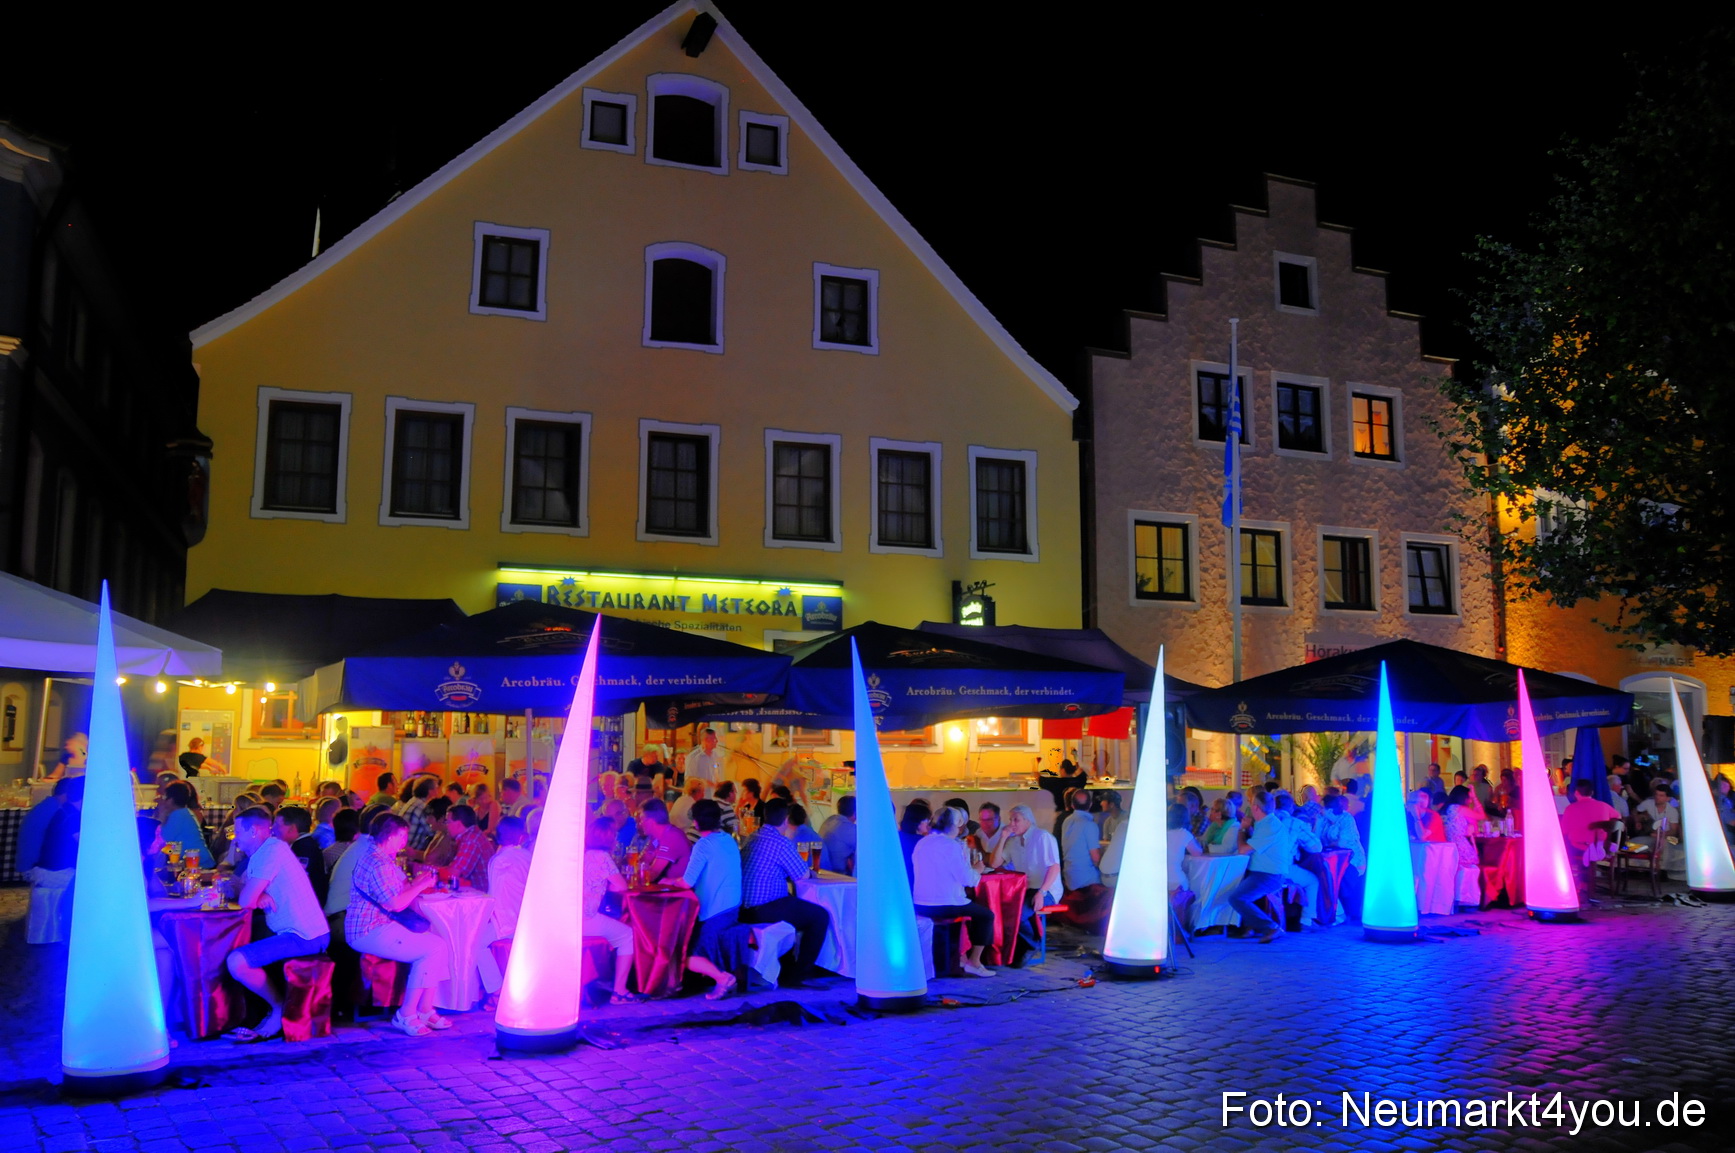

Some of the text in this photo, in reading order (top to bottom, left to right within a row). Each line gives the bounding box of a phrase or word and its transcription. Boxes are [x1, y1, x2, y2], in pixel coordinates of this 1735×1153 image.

[547, 584, 691, 612] RESTAURANT
[702, 593, 798, 617] METEORA
[674, 620, 742, 633] Spezialitäten
[501, 674, 727, 688] Arcobräu. Gchmack, der verbindet.
[906, 685, 1075, 697] Arcobräu. Geschmack, der verbindet.
[1266, 712, 1304, 721] Arcobräu.
[1306, 712, 1354, 723] Geschmack,
[1357, 715, 1371, 723] der
